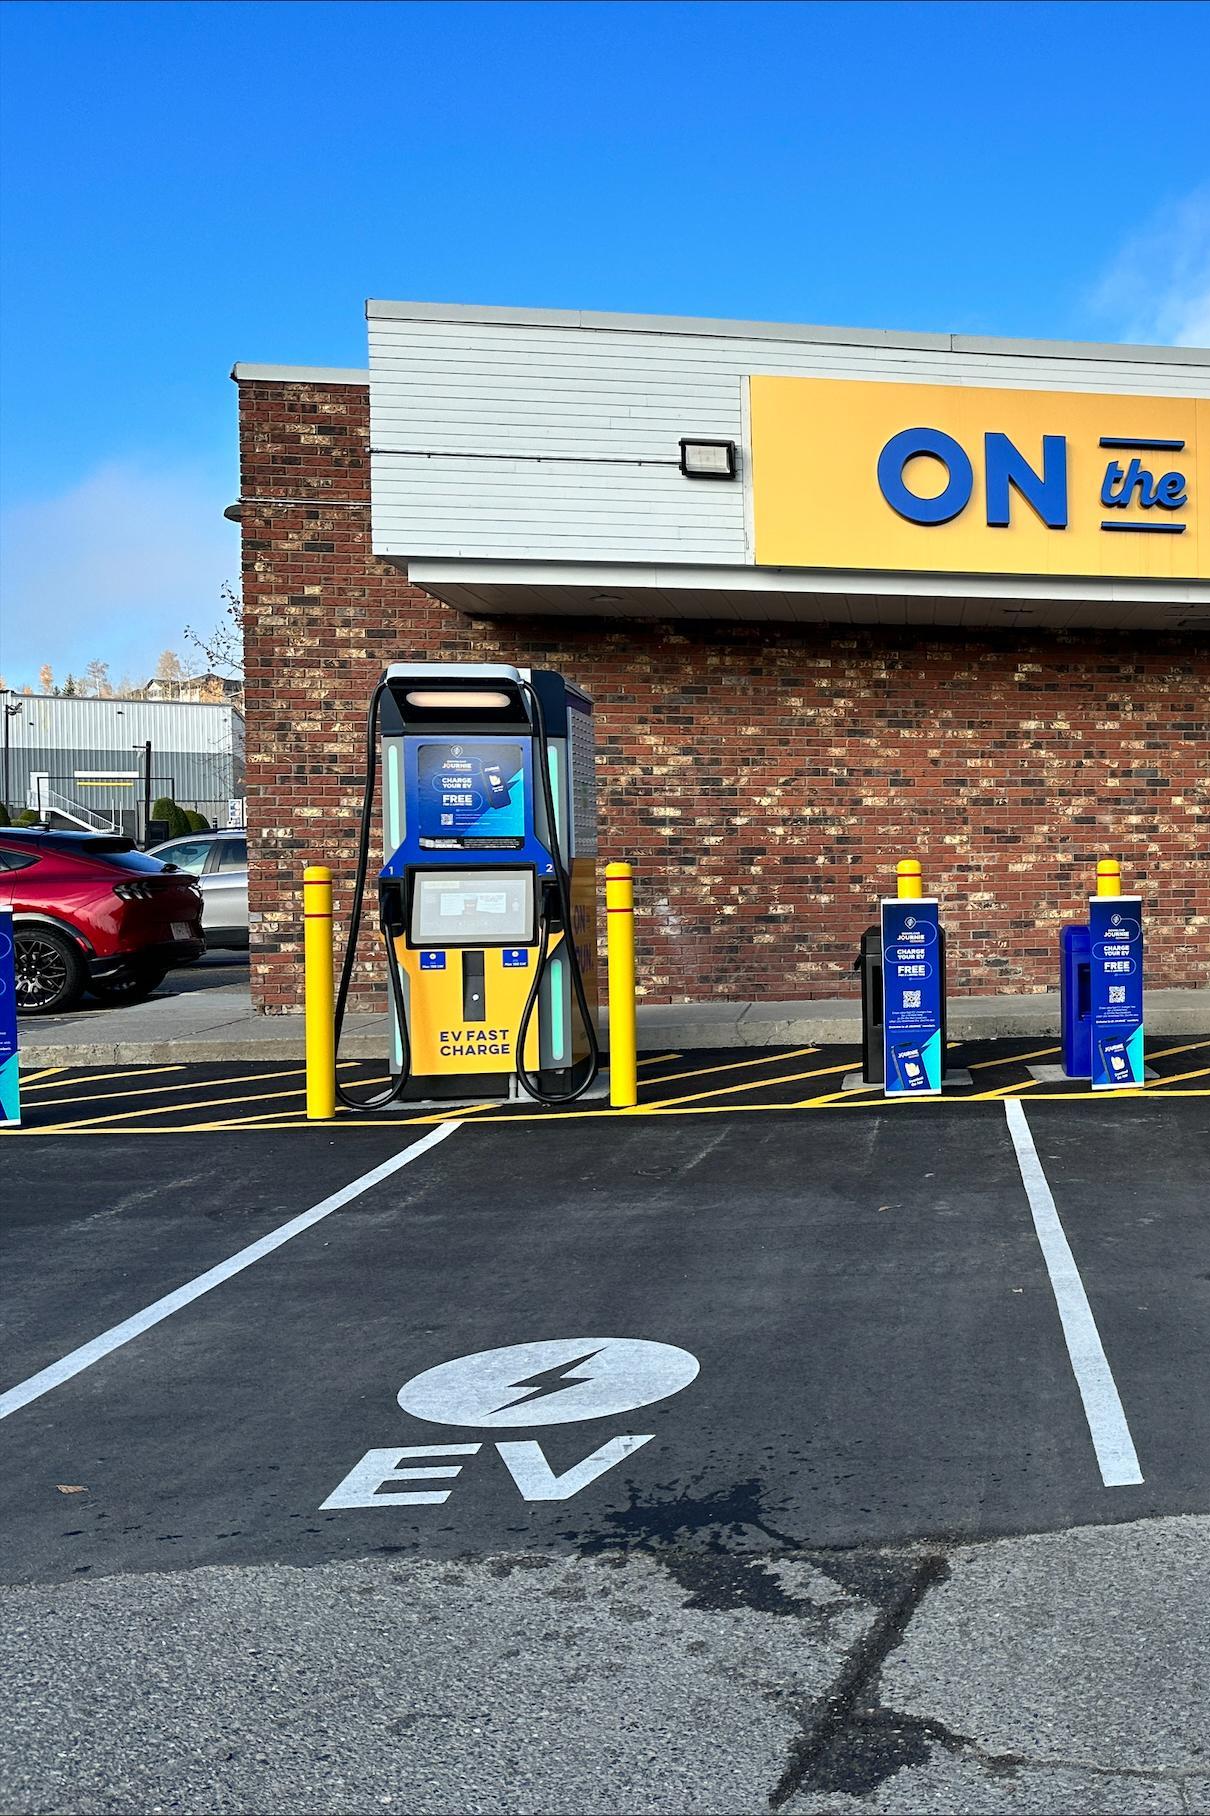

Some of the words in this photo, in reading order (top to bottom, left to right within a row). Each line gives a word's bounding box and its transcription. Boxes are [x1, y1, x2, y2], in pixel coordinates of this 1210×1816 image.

[877, 427, 1068, 529] ON
[1100, 459, 1187, 511] the
[442, 794, 473, 803] FREE
[388, 866, 394, 875] 1
[545, 863, 553, 873] 2
[897, 965, 926, 974] FREE
[1103, 961, 1130, 970] FREE
[439, 1030, 462, 1042] EV
[466, 1029, 509, 1041] FAST
[439, 1044, 511, 1057] CHARGE
[318, 1434, 656, 1510] EV
